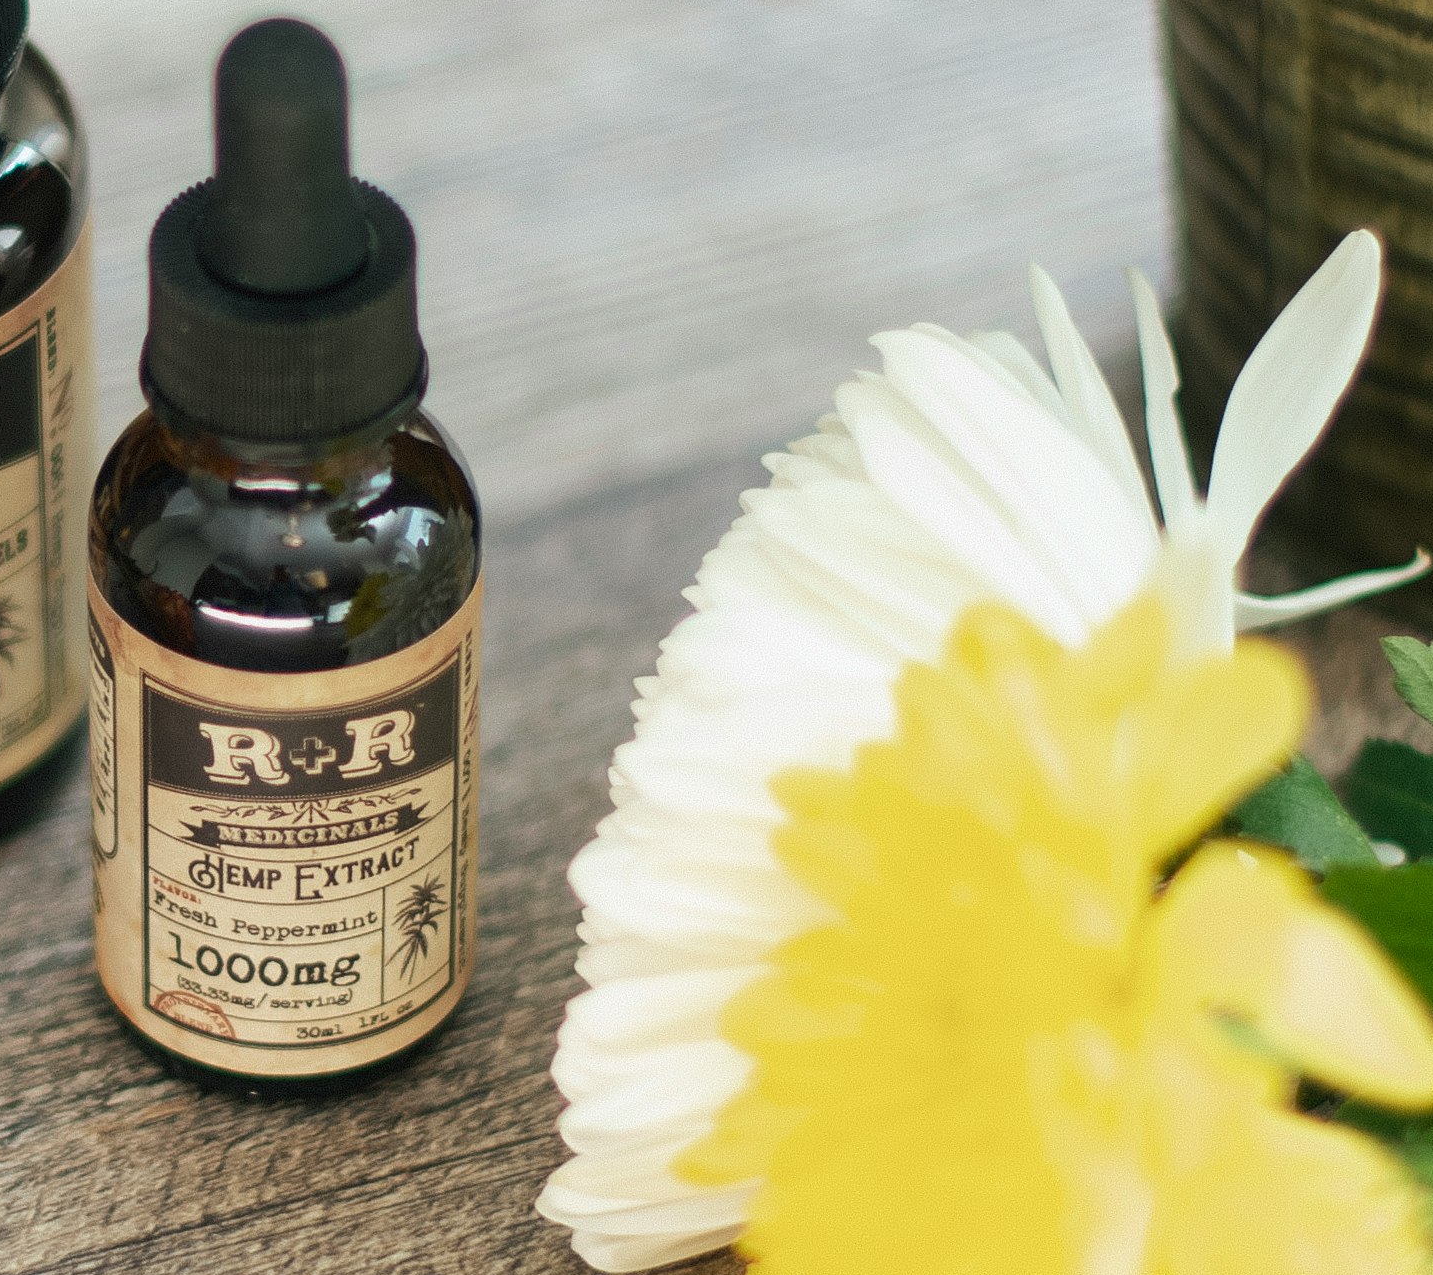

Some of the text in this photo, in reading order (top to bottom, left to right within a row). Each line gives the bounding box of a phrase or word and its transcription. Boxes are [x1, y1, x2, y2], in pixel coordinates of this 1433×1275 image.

[199, 709, 416, 786] R+R
[218, 810, 398, 845] MEDICINALS
[188, 835, 420, 901] HEMP EXTRACT
[154, 888, 378, 941] Fresh Peppermint
[168, 930, 360, 988] 1000mg
[296, 1024, 343, 1040] 30ml
